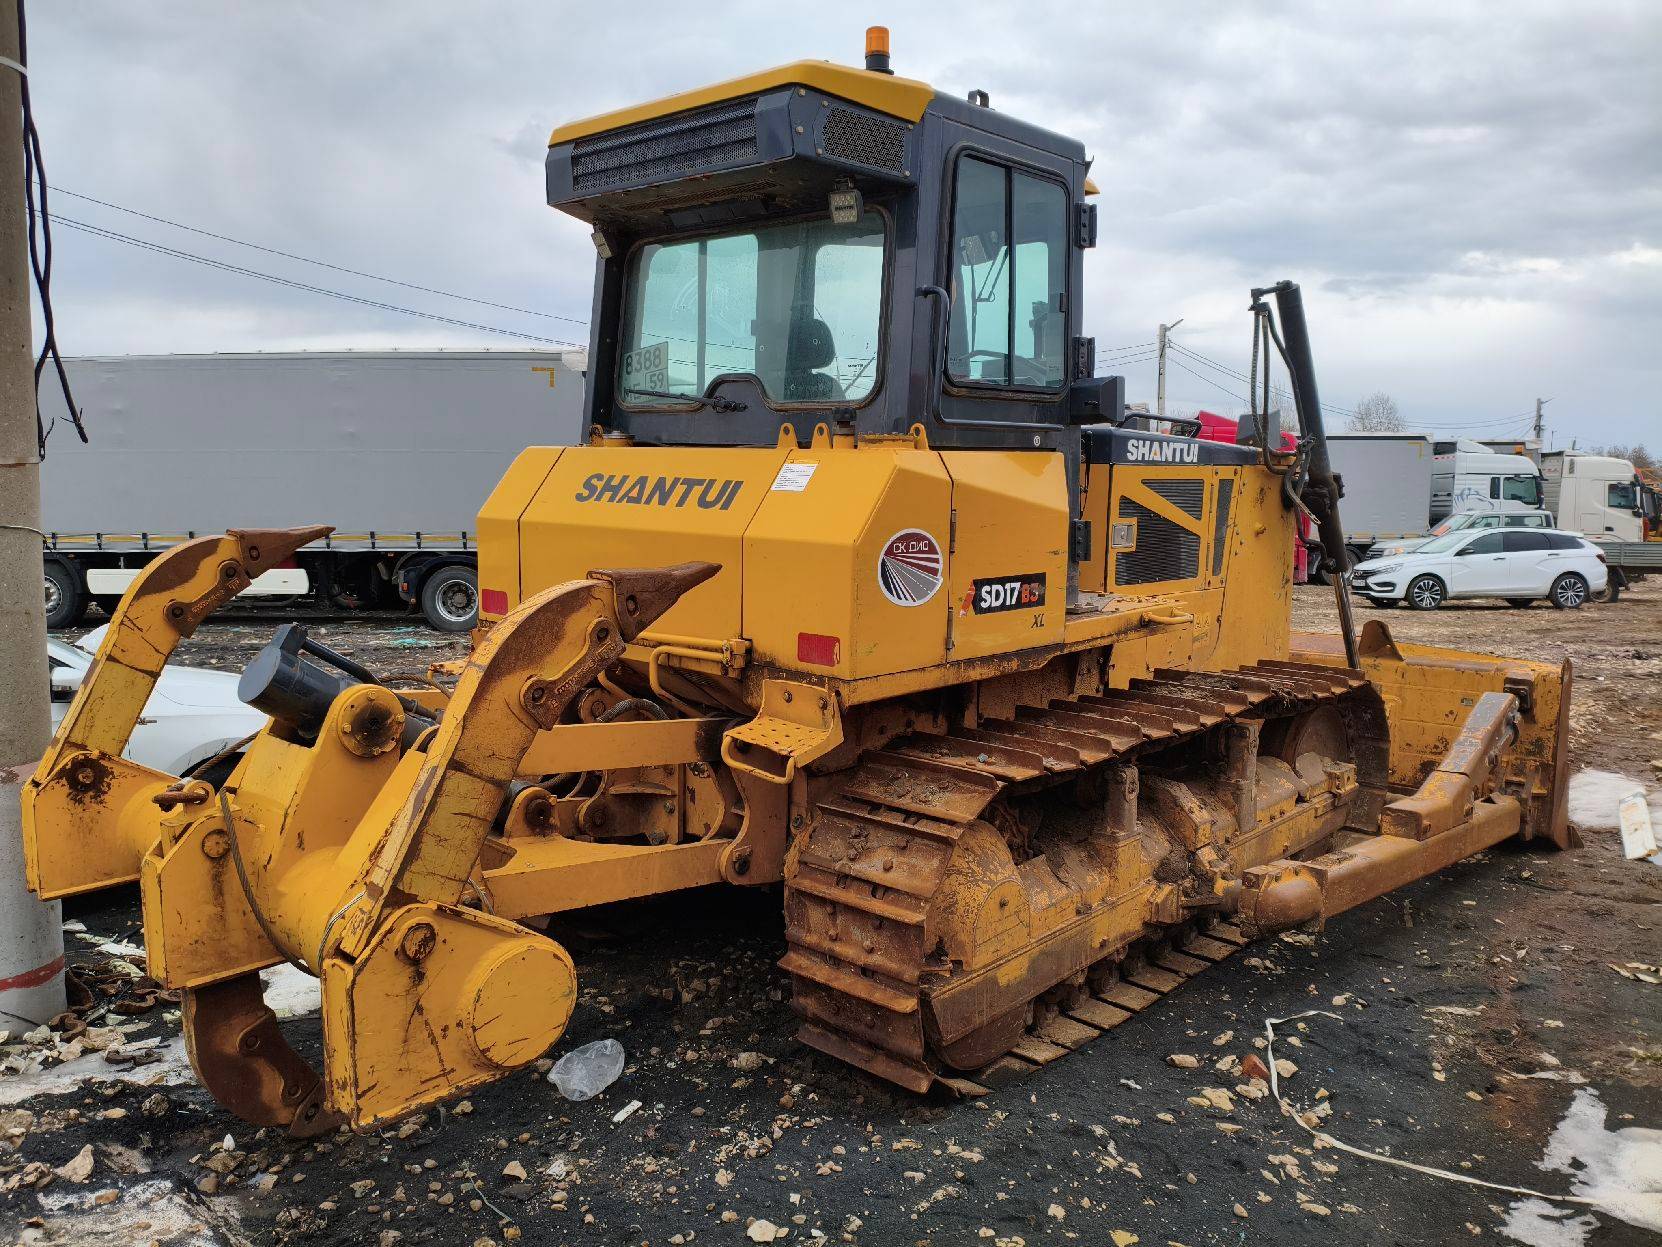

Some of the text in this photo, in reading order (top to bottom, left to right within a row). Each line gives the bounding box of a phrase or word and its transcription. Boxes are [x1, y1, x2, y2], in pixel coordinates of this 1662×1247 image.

[625, 347, 662, 376] 8388
[650, 372, 665, 390] 59
[1126, 438, 1199, 463] SHANTUI
[575, 472, 744, 511] SHANTUI
[1030, 613, 1045, 629] XL
